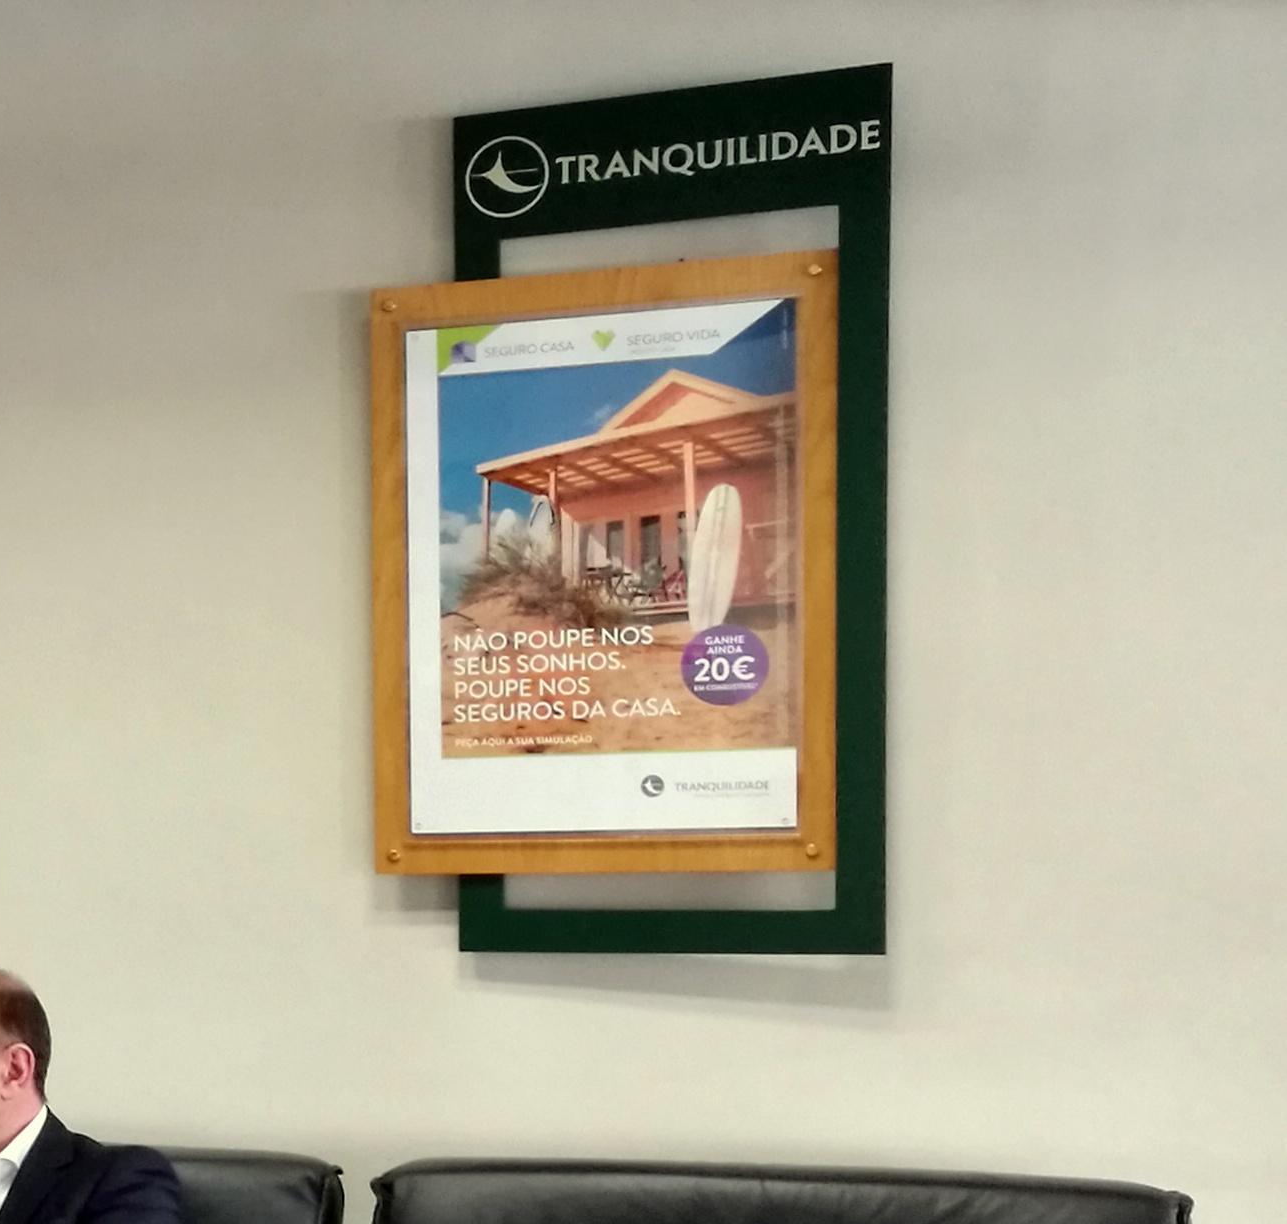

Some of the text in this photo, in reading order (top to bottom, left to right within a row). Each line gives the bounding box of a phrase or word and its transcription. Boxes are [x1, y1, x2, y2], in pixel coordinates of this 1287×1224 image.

[555, 119, 881, 185] TRANQUILIDADE
[626, 328, 721, 346] SEGURO VIDA
[484, 340, 575, 358] SEGURO CASA
[453, 625, 654, 652] NÃO POUPE NOS
[705, 634, 745, 646] GANHE
[706, 645, 743, 655] AINDA
[453, 650, 627, 676] SEUS SONHOS.
[693, 655, 756, 682] 20€
[454, 676, 591, 699] POUPE NOS
[453, 697, 682, 723] SEGUROS DA CASA.
[515, 736, 535, 745] SUA
[674, 780, 770, 792] TRANQUILIDADE
